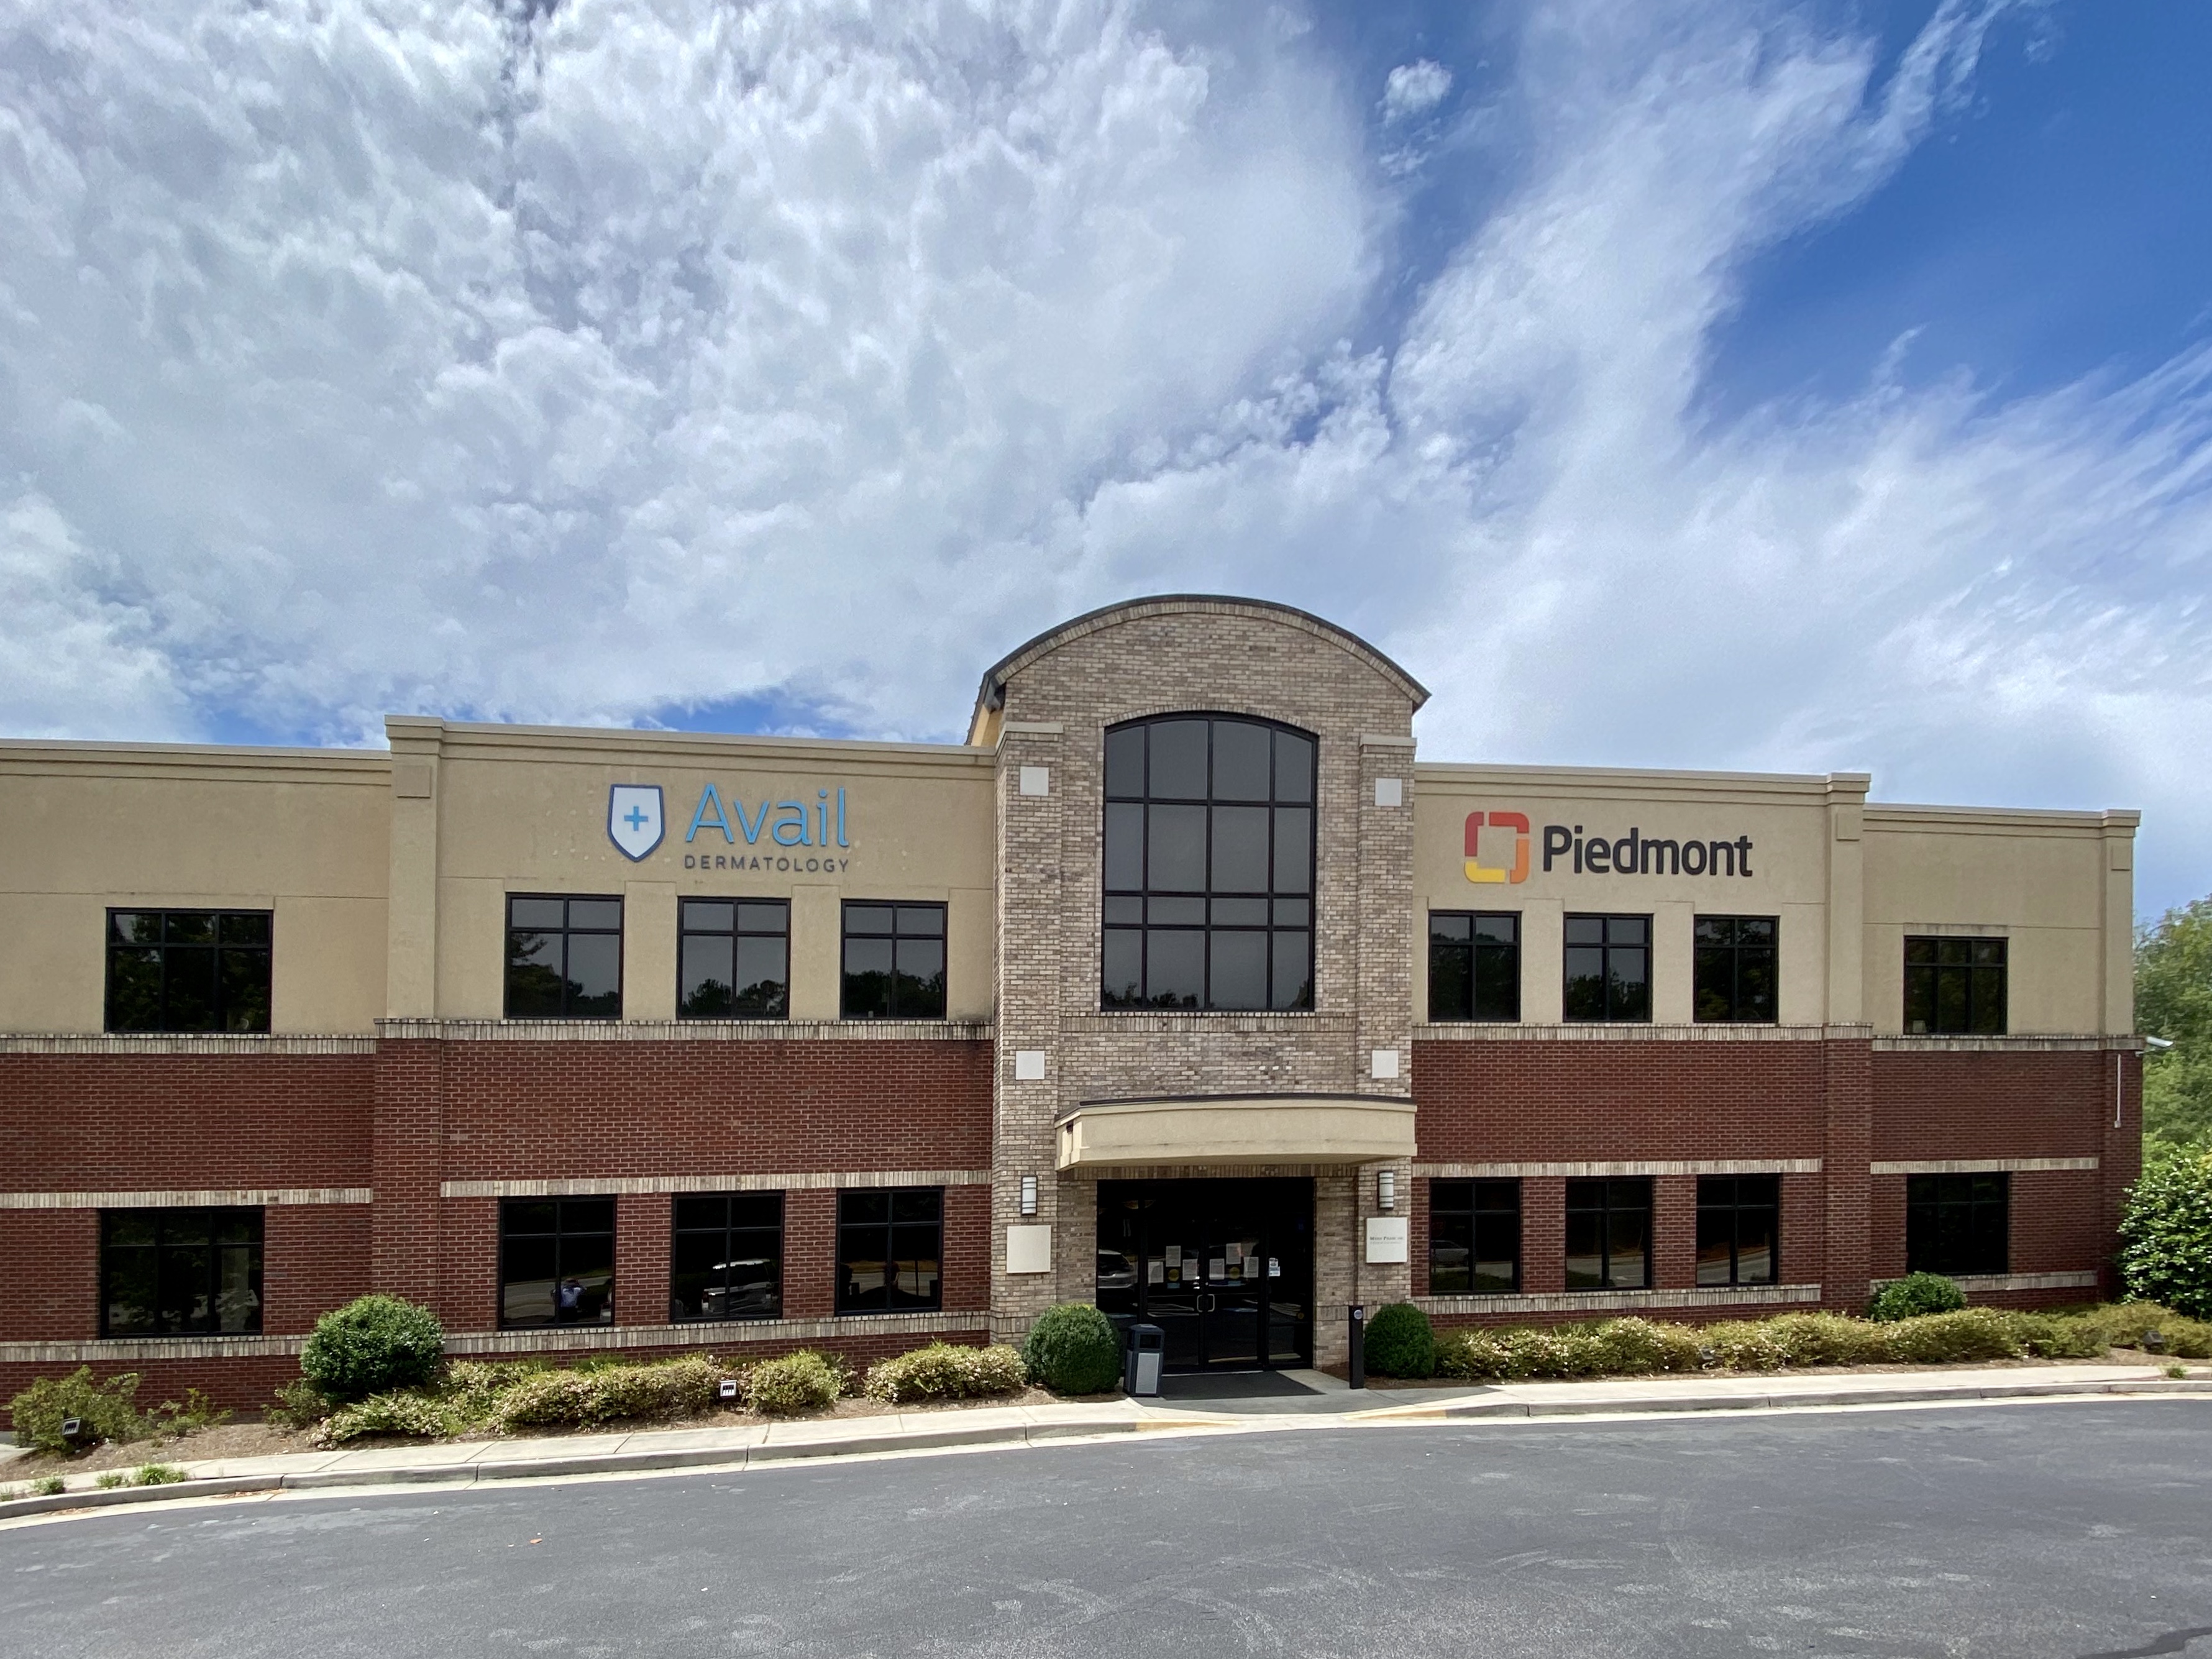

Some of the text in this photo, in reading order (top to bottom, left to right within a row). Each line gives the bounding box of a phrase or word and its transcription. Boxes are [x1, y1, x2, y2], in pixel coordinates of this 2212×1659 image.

[686, 783, 849, 847] Avail
[685, 855, 849, 872] DERMATOLOGY
[1543, 825, 1753, 877] Piedmont
